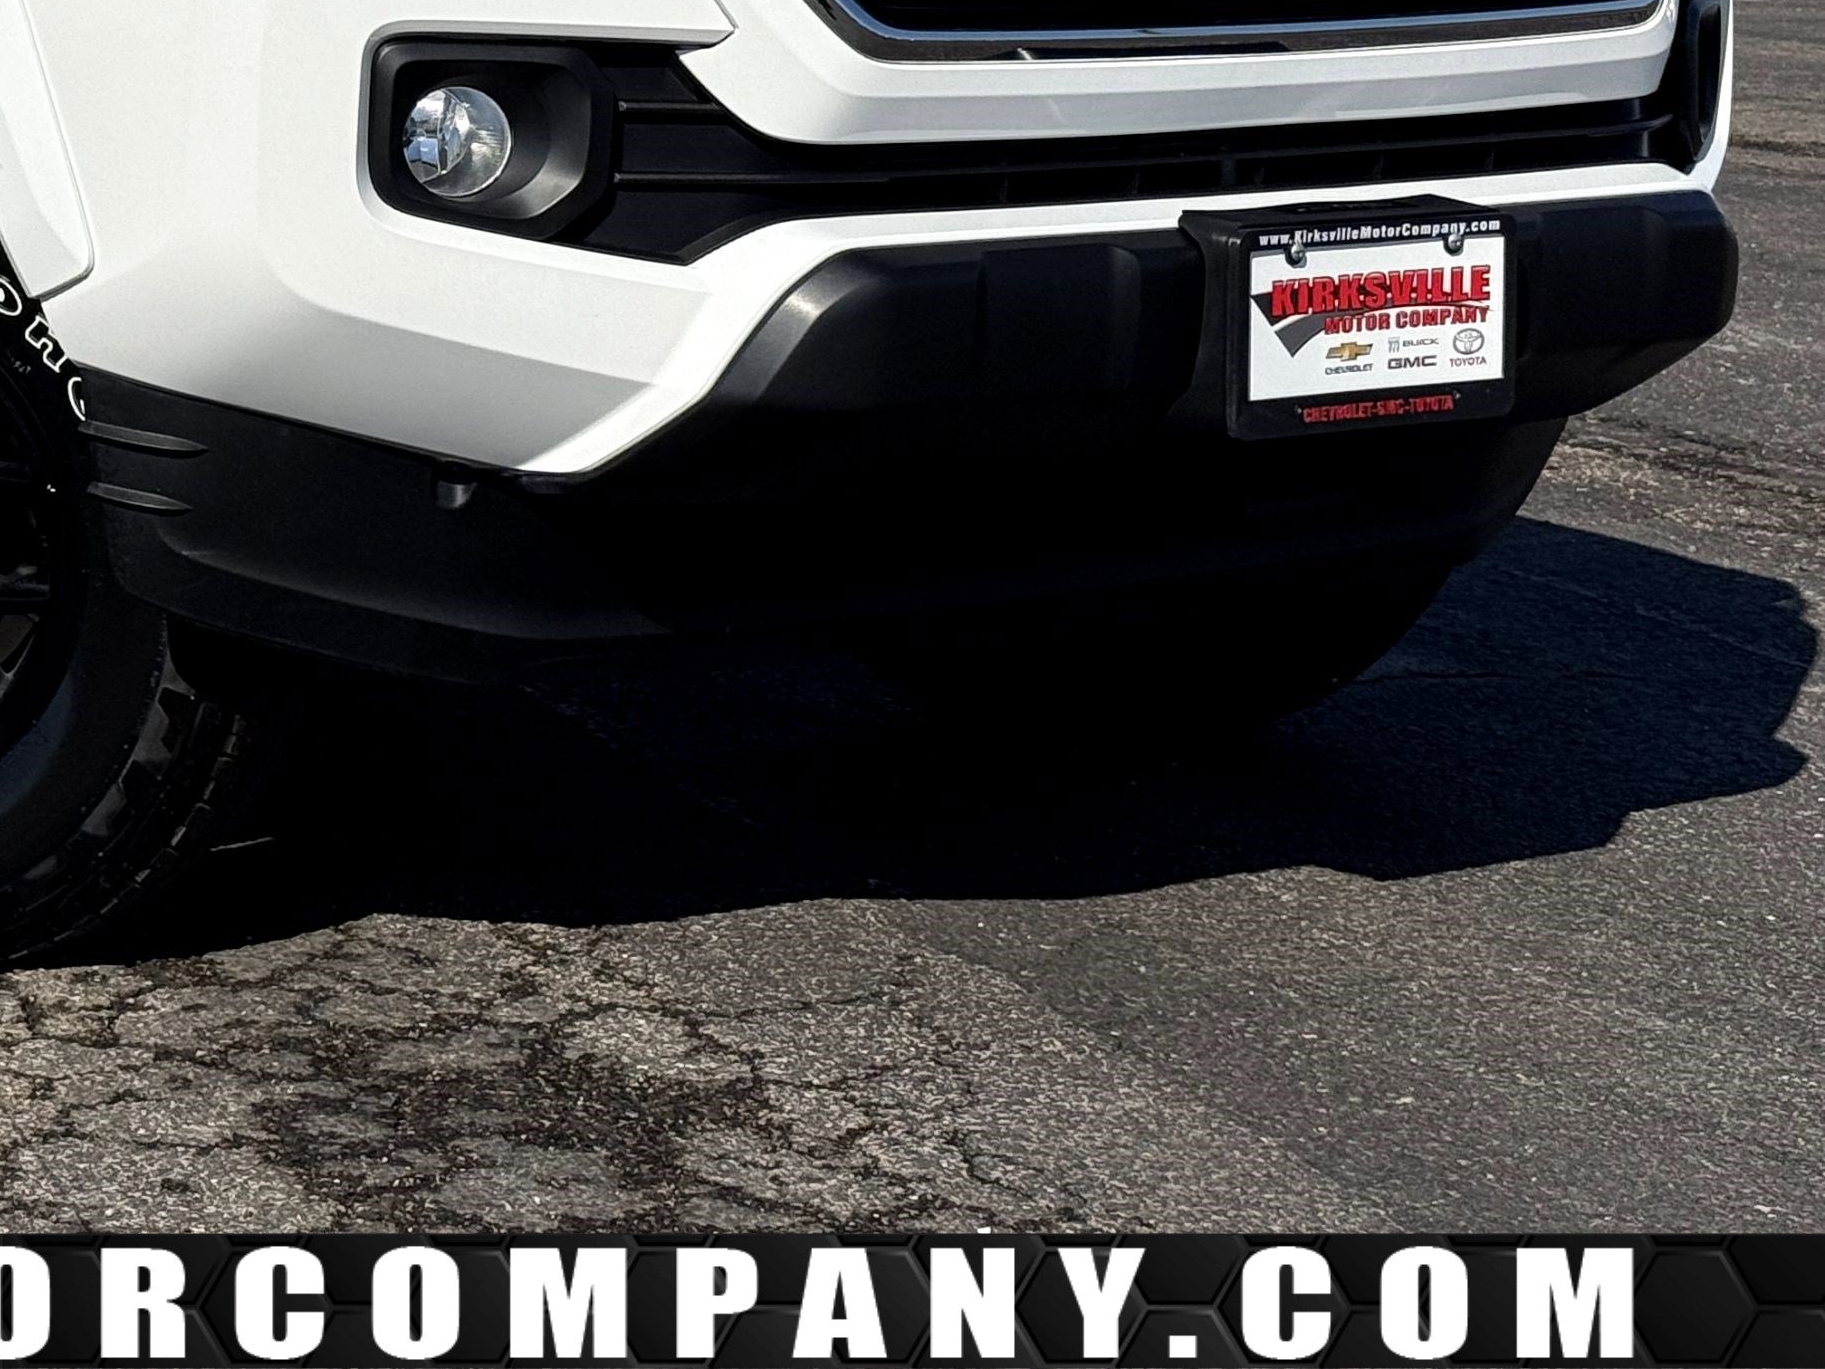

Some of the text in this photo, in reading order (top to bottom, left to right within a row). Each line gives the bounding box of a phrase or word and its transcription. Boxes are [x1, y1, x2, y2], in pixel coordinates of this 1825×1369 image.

[1259, 219, 1501, 247] www.KirksvilleMotorCompany.com
[1271, 264, 1491, 317] KIRKSVILLE
[1324, 304, 1491, 335] MOTOR COMPANY
[1402, 337, 1440, 348] BUICK
[1387, 355, 1438, 369] GMC
[1449, 356, 1488, 368] TOYOTA
[1325, 363, 1374, 376] CHEVROLET
